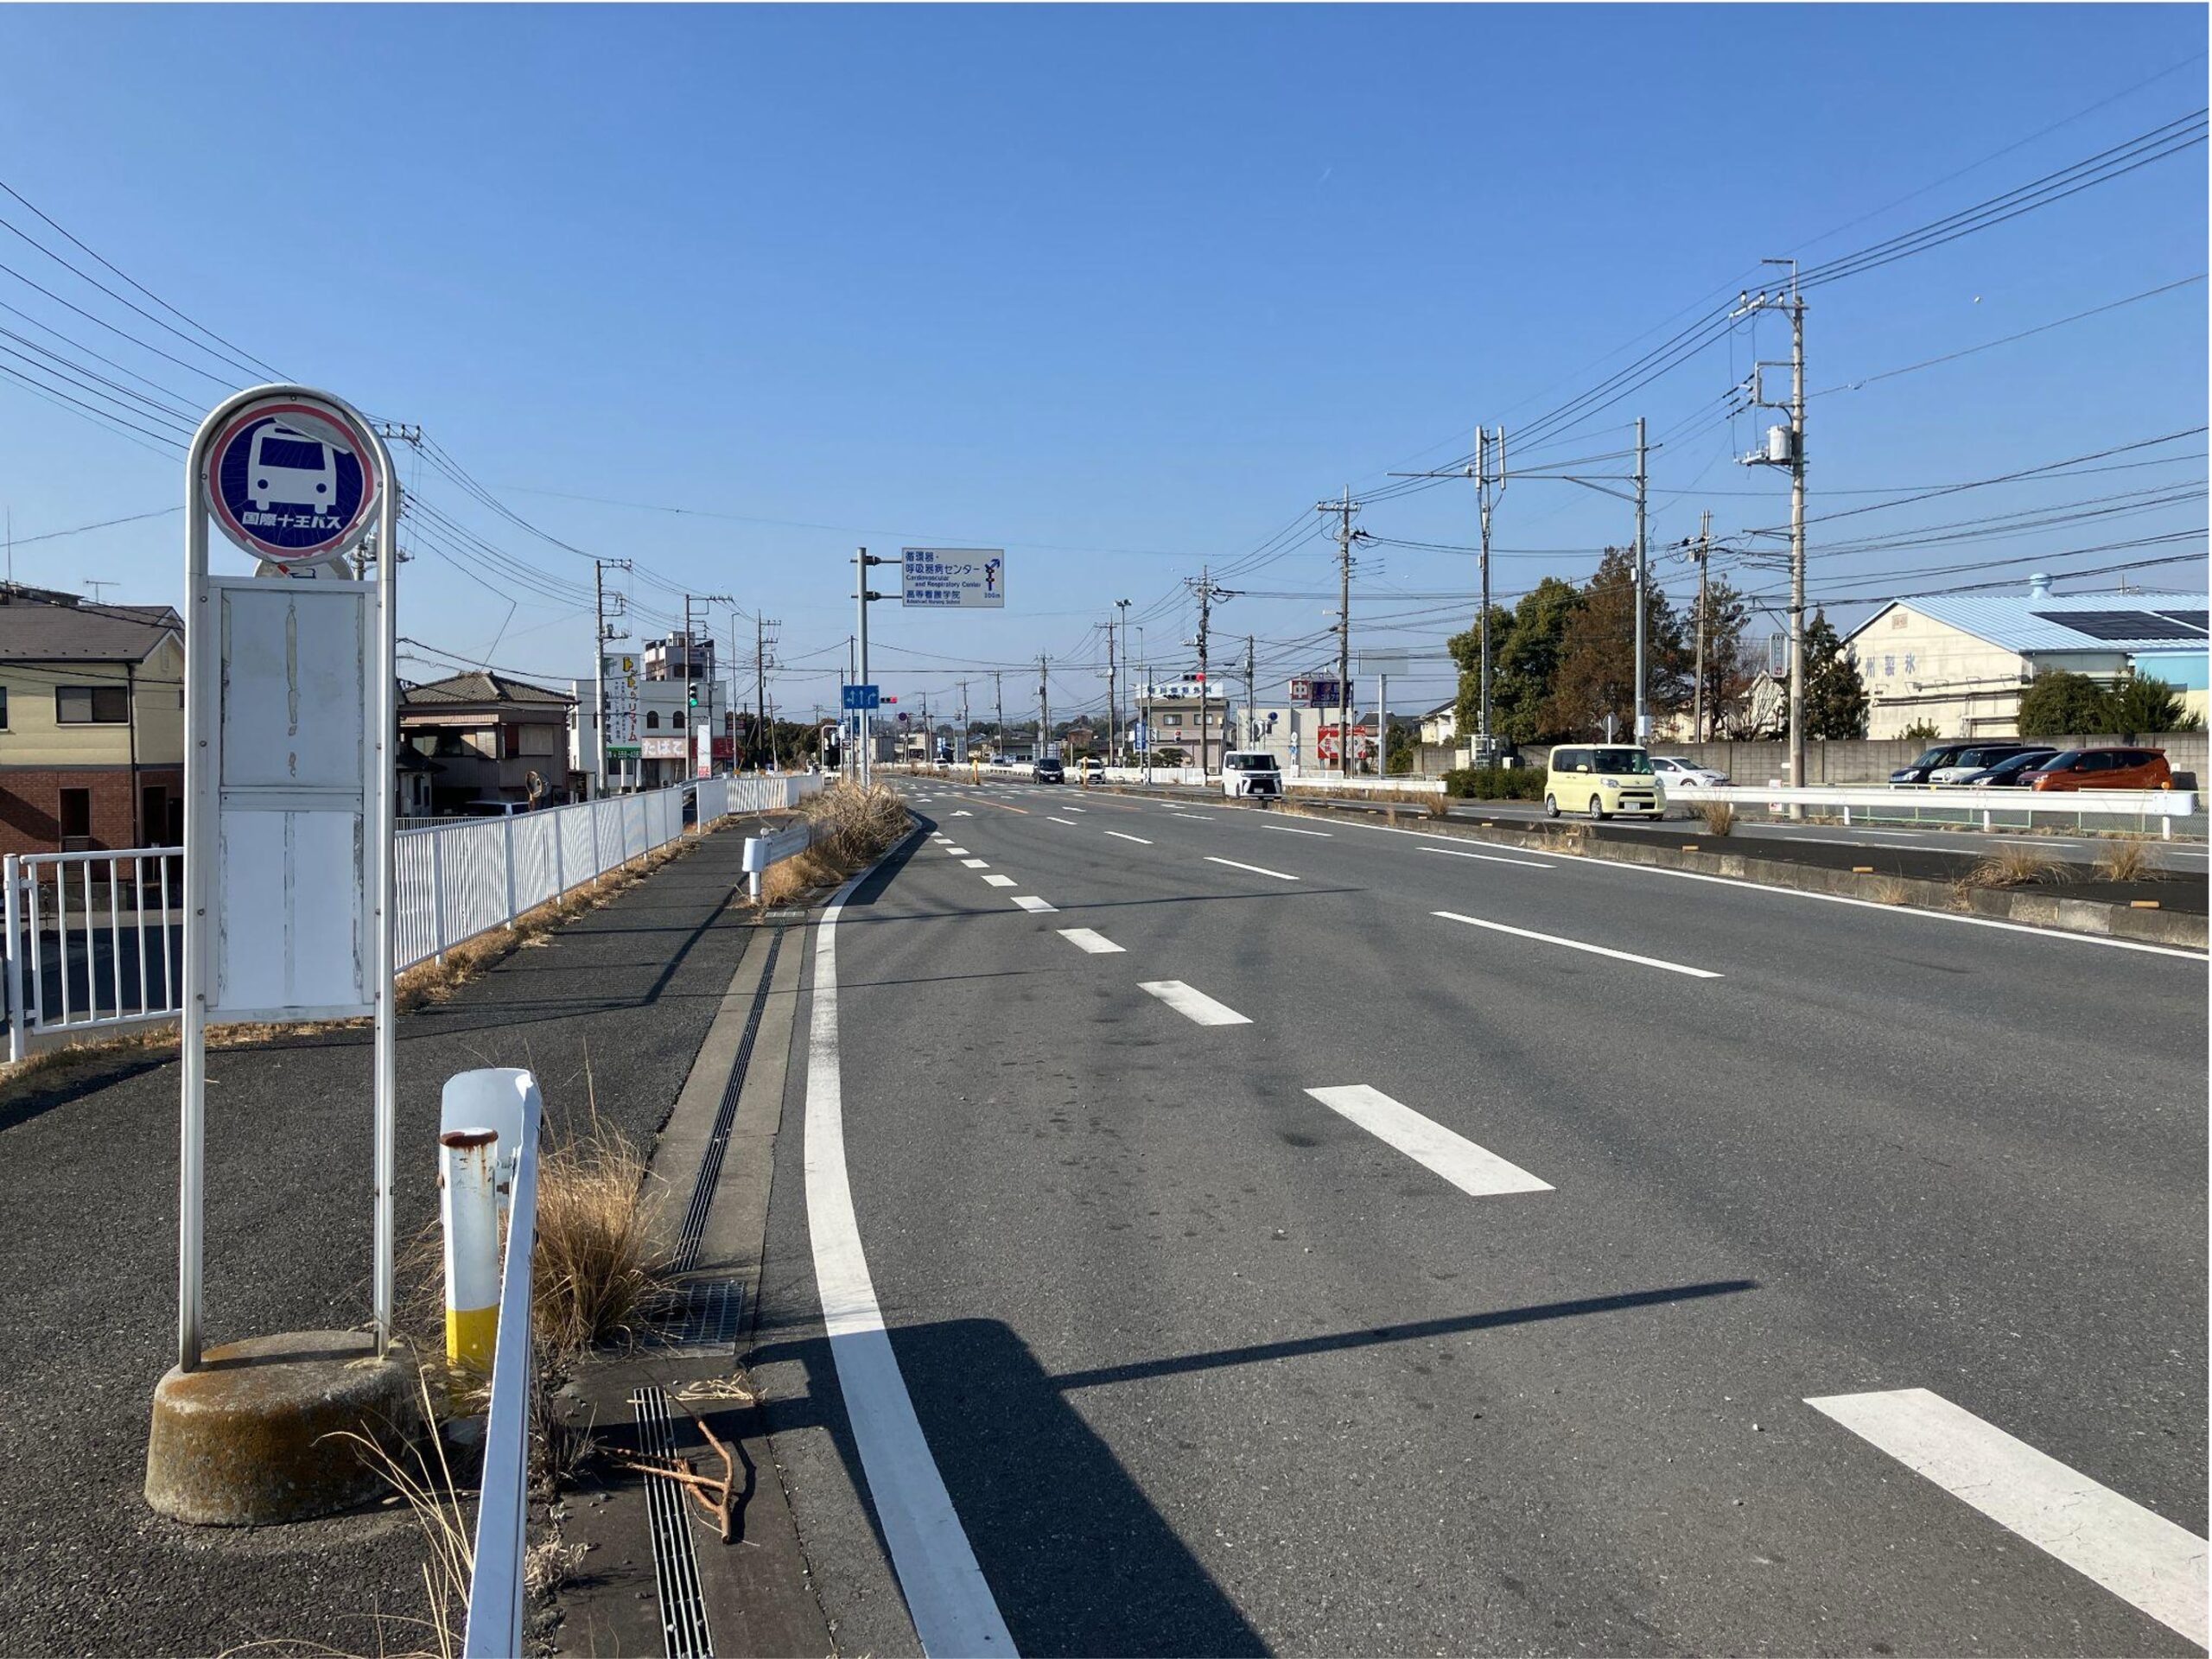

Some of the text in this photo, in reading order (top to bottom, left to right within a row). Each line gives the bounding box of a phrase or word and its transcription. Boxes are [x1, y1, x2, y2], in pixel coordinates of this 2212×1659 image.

[242, 512, 342, 530] 国際十王バス
[906, 563, 980, 575] 呼吸器病センター
[906, 590, 961, 600] 高等看護学院
